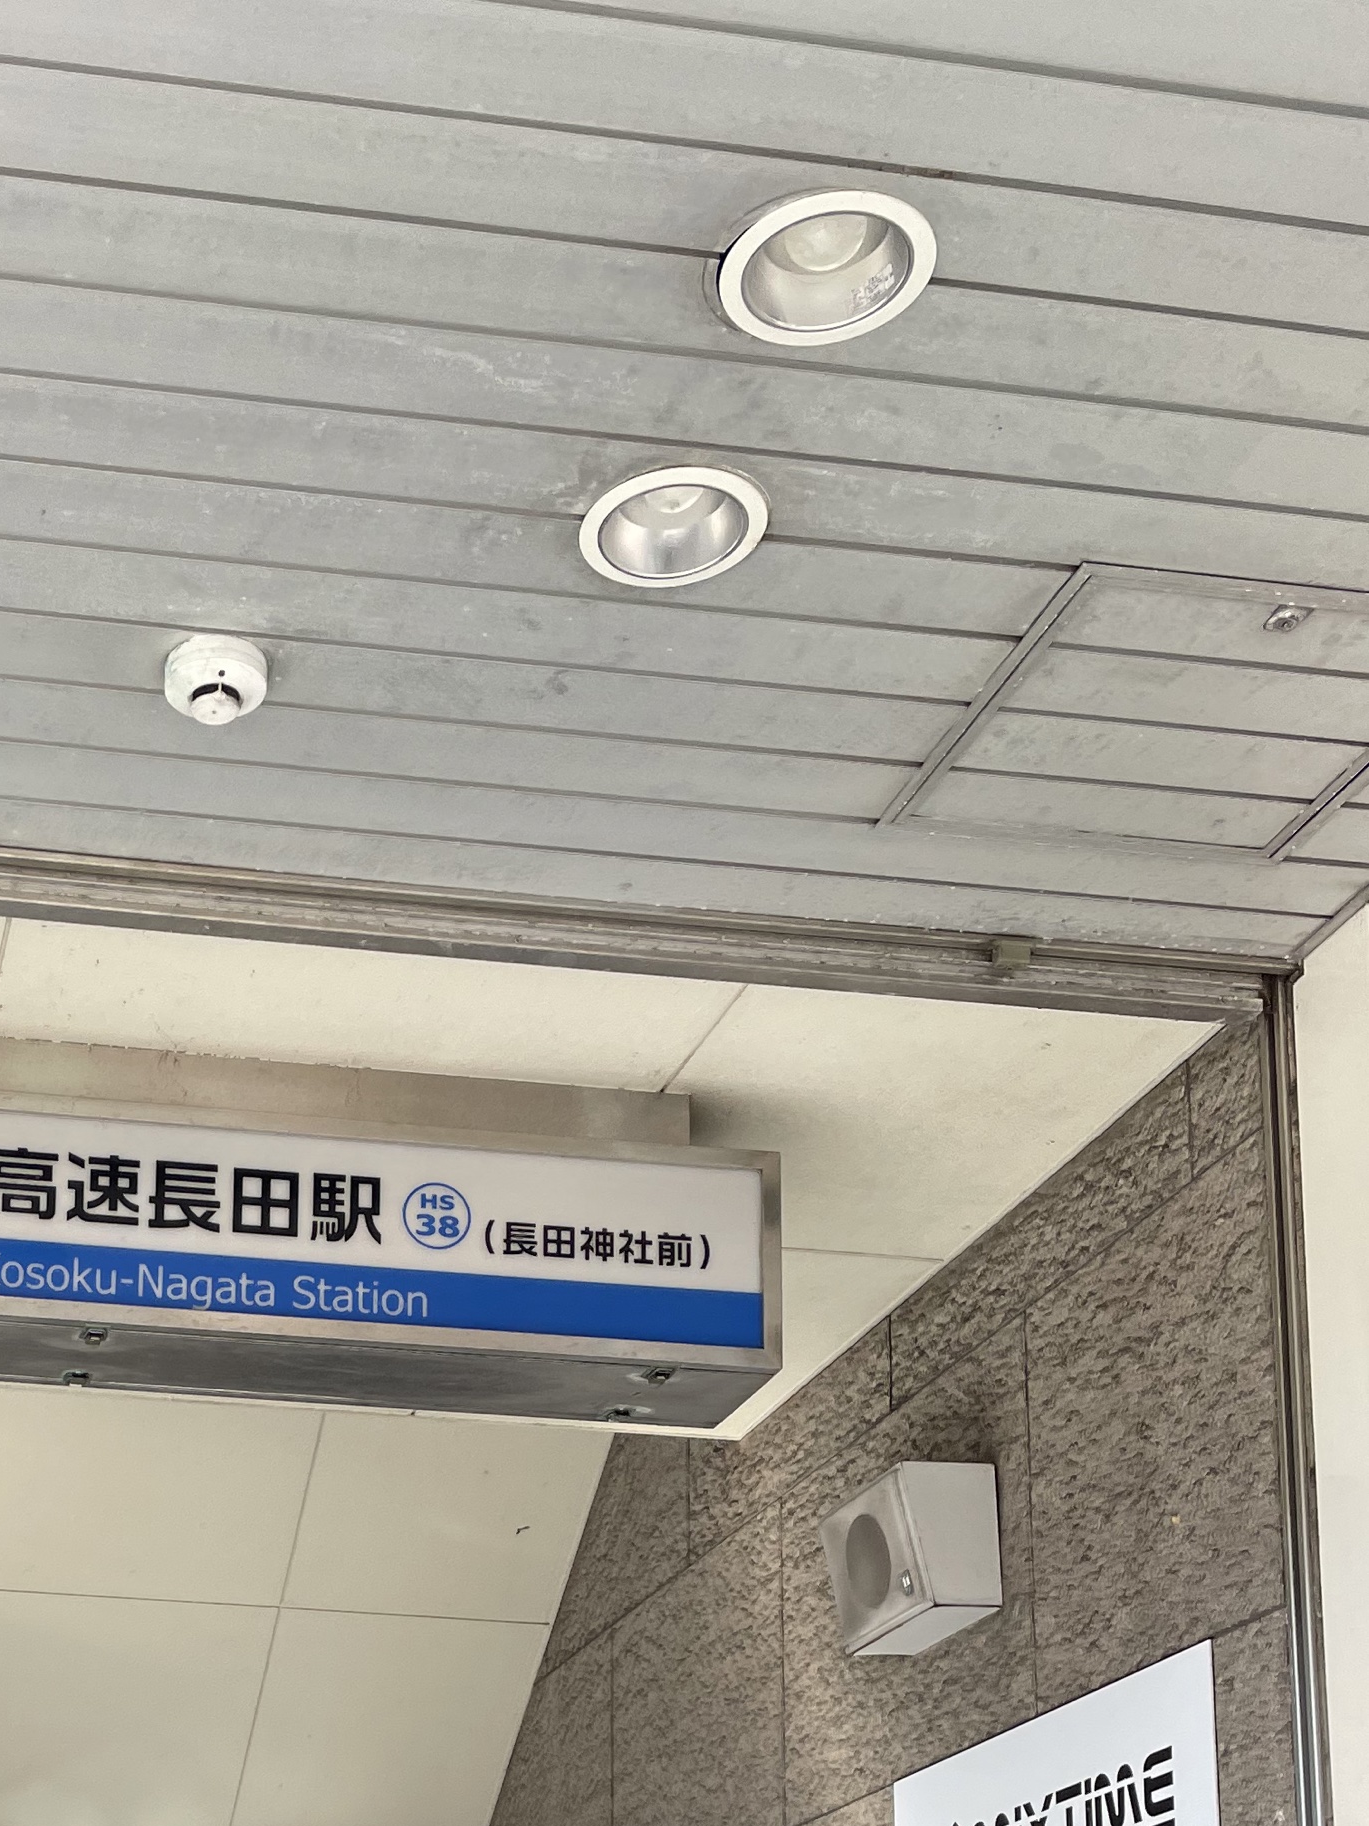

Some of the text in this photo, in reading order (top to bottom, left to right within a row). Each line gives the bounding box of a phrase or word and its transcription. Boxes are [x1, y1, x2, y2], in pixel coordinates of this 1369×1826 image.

[420, 1193, 455, 1211] HS
[416, 1213, 460, 1239] 38
[293, 1275, 428, 1317] Station
